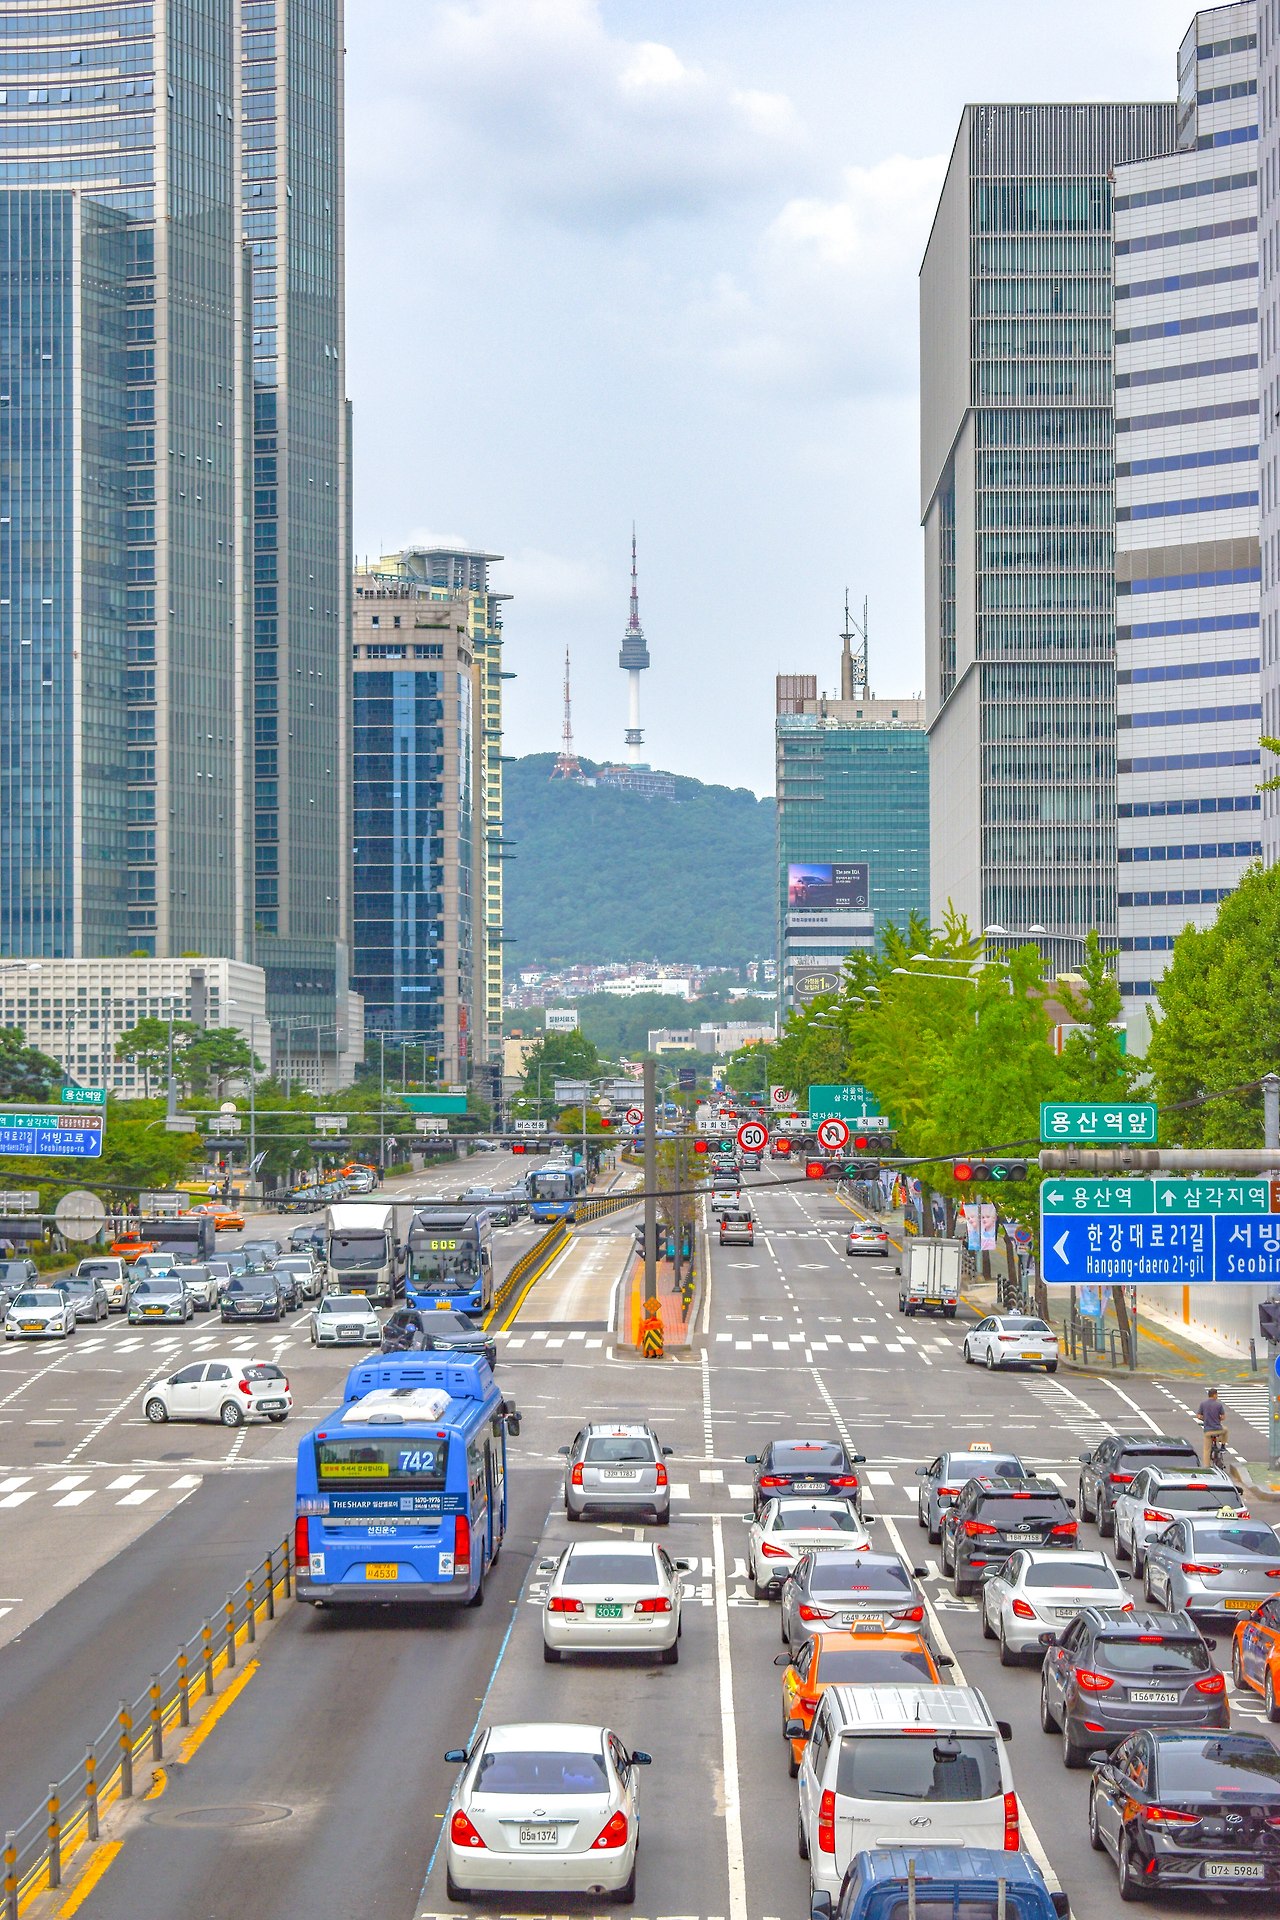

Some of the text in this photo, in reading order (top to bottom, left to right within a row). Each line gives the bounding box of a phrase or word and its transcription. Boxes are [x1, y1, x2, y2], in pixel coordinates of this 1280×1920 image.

[66, 1090, 102, 1101] 용산역앞
[26, 1119, 57, 1127] 삼각지역
[517, 1121, 545, 1129] 버스전용
[1051, 1112, 1148, 1134] 용산역앞
[0, 1132, 32, 1144] 대로21길
[41, 1132, 84, 1144] 서빙고로
[746, 1130, 761, 1144] 50
[40, 1144, 84, 1153] Seobinggo-ro
[1072, 1187, 1132, 1209] 용산역
[1184, 1188, 1265, 1209] 삼각지역
[1087, 1224, 1204, 1252] 한강대로21길
[431, 1240, 456, 1250] 605
[1087, 1256, 1204, 1277] Hangang-daero 21-gil
[400, 1451, 434, 1471] 742
[597, 1608, 621, 1616] 3037
[537, 1831, 556, 1840] 1374
[1211, 1866, 1258, 1876] 07소 5984
